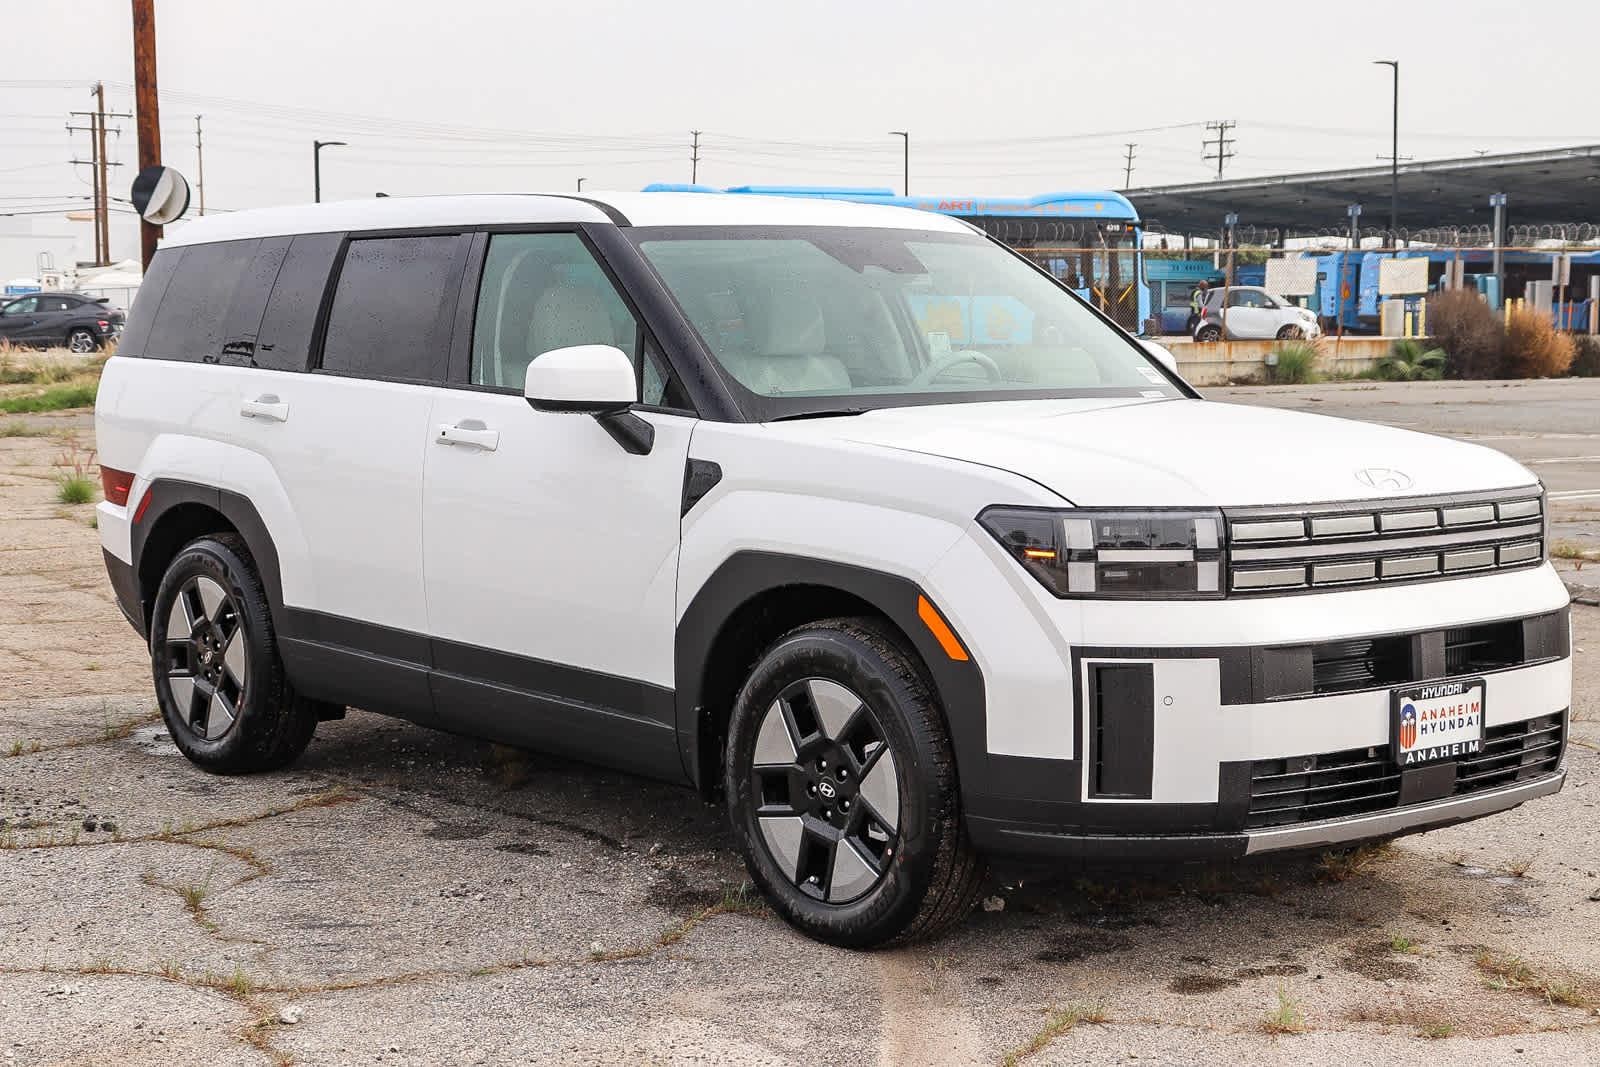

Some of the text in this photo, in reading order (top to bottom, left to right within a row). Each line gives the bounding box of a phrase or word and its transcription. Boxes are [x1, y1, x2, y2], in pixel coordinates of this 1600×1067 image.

[938, 199, 974, 210] ART
[1421, 683, 1463, 698] HYUNDAI
[1420, 701, 1480, 720] ANAHEIM
[1420, 714, 1480, 735] HYUNDAI
[1405, 740, 1479, 764] ANAHEIM
